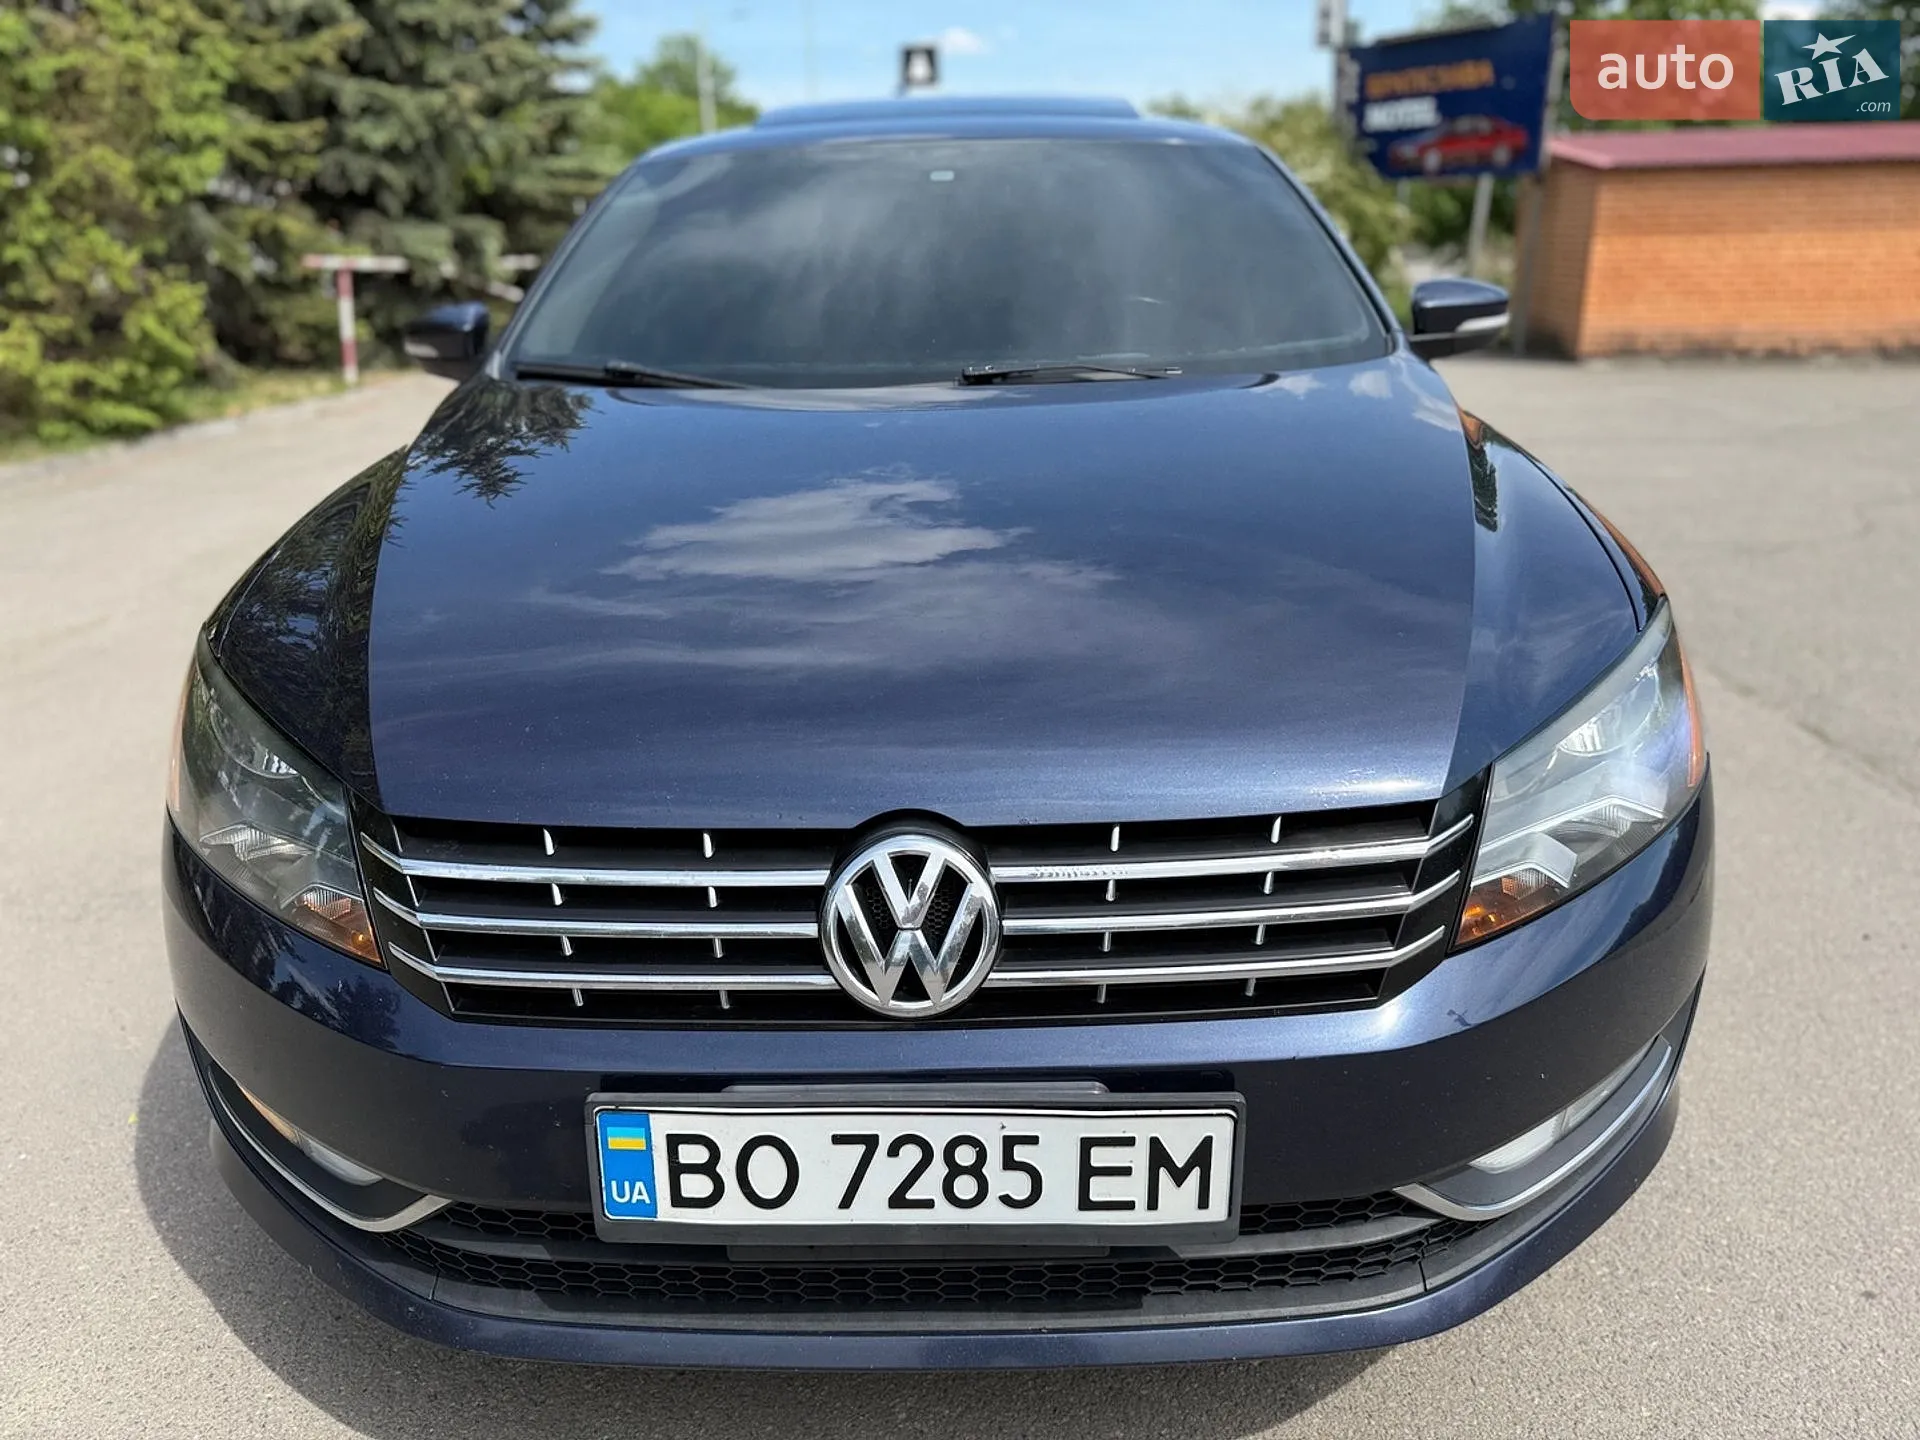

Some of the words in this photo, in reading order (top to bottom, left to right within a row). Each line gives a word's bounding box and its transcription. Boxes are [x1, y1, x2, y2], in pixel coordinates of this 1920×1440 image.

[611, 1180, 650, 1204] UA
[665, 1133, 800, 1210] BO
[831, 1133, 1043, 1209] 7285
[1078, 1135, 1213, 1211] EM
